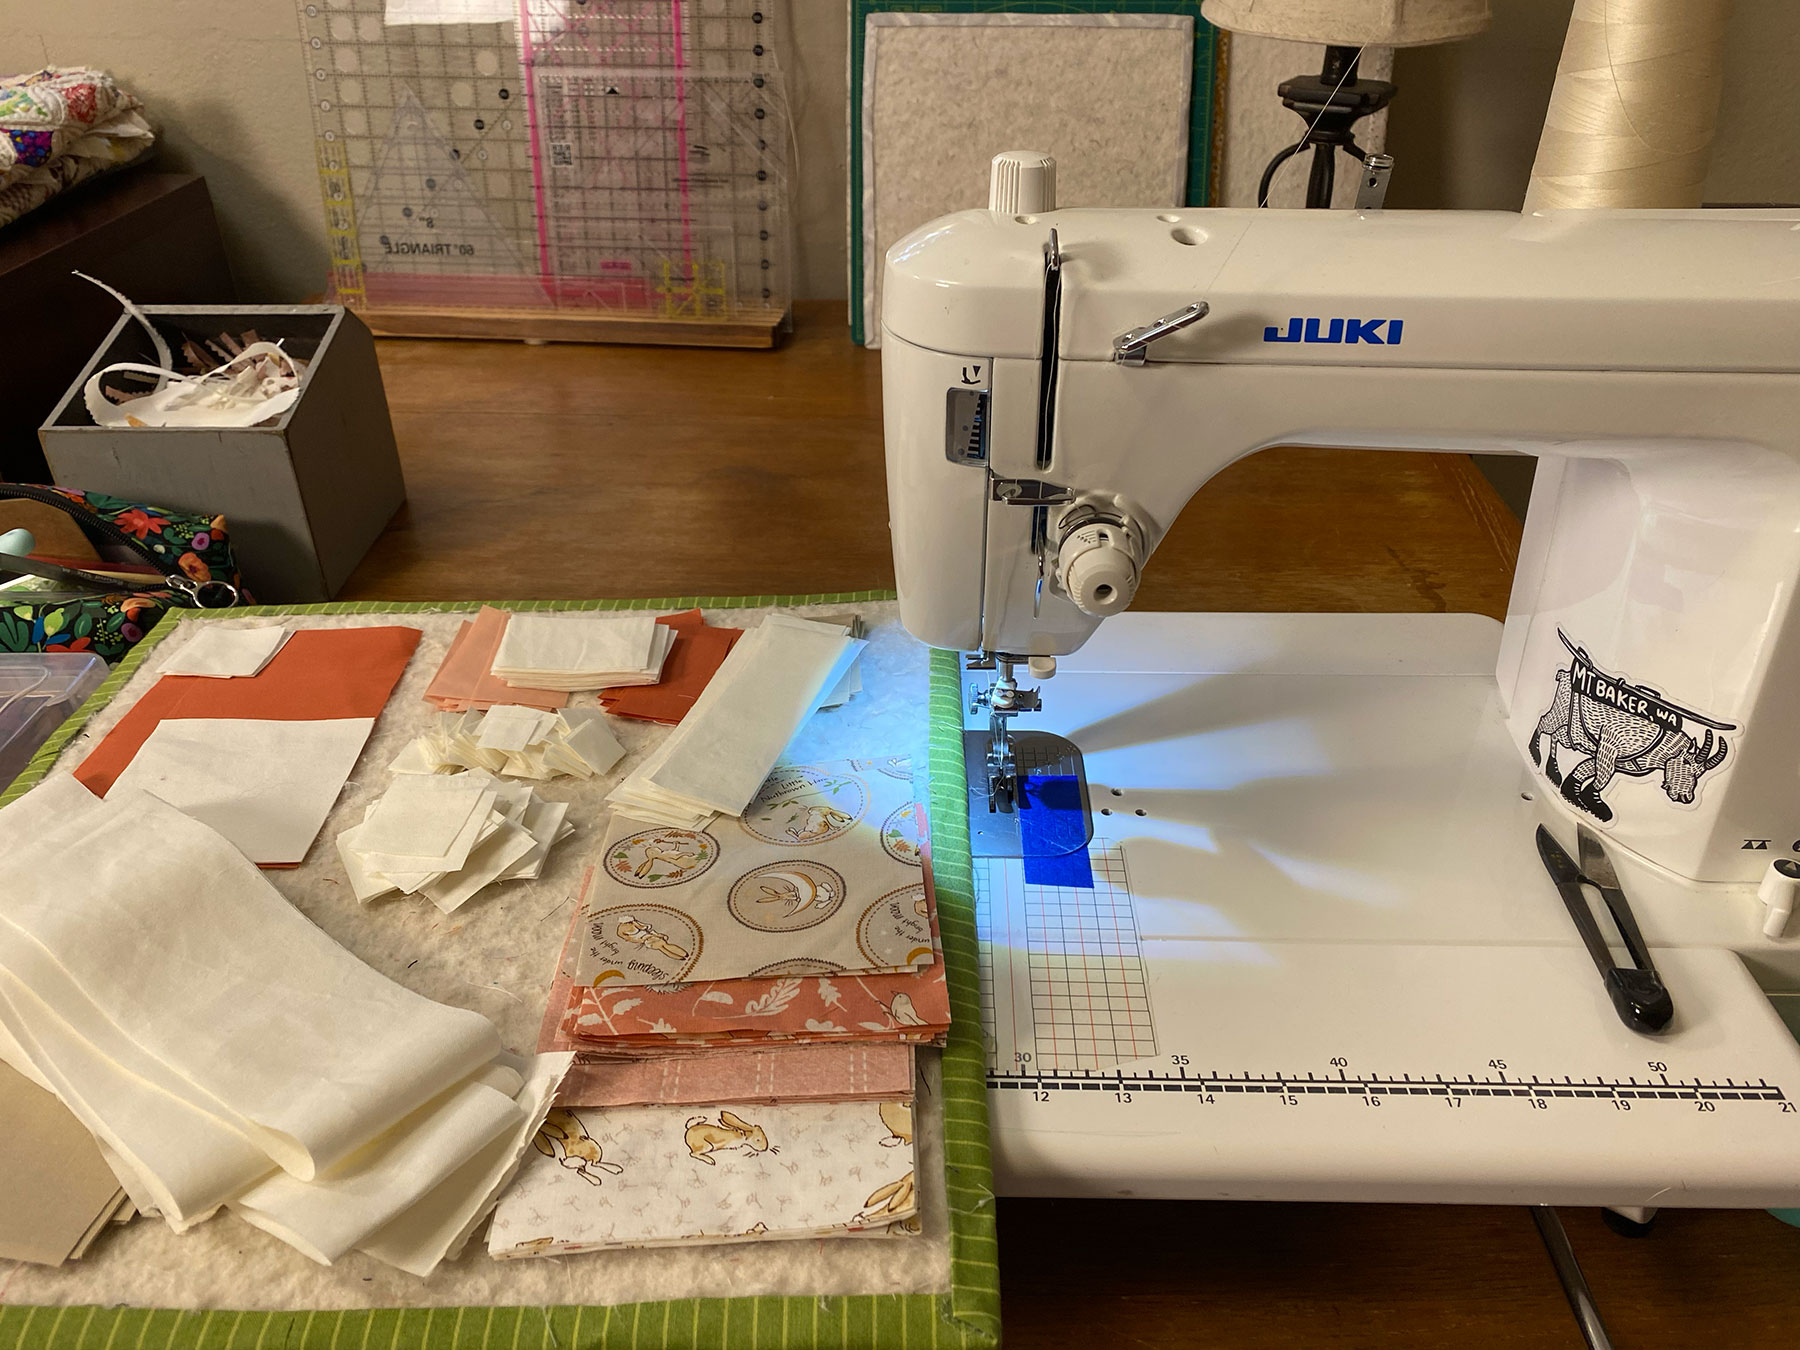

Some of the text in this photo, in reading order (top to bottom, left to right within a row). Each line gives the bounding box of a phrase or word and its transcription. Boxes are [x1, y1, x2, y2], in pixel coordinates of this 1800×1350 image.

[1264, 318, 1403, 344] JUKI
[1572, 661, 1596, 697] MT.
[1656, 707, 1678, 727] WA
[1014, 1052, 1667, 1072] 30 35 40 45 50
[1033, 1091, 1797, 1113] 12 13 14 15 16 17 18 19 20 21
